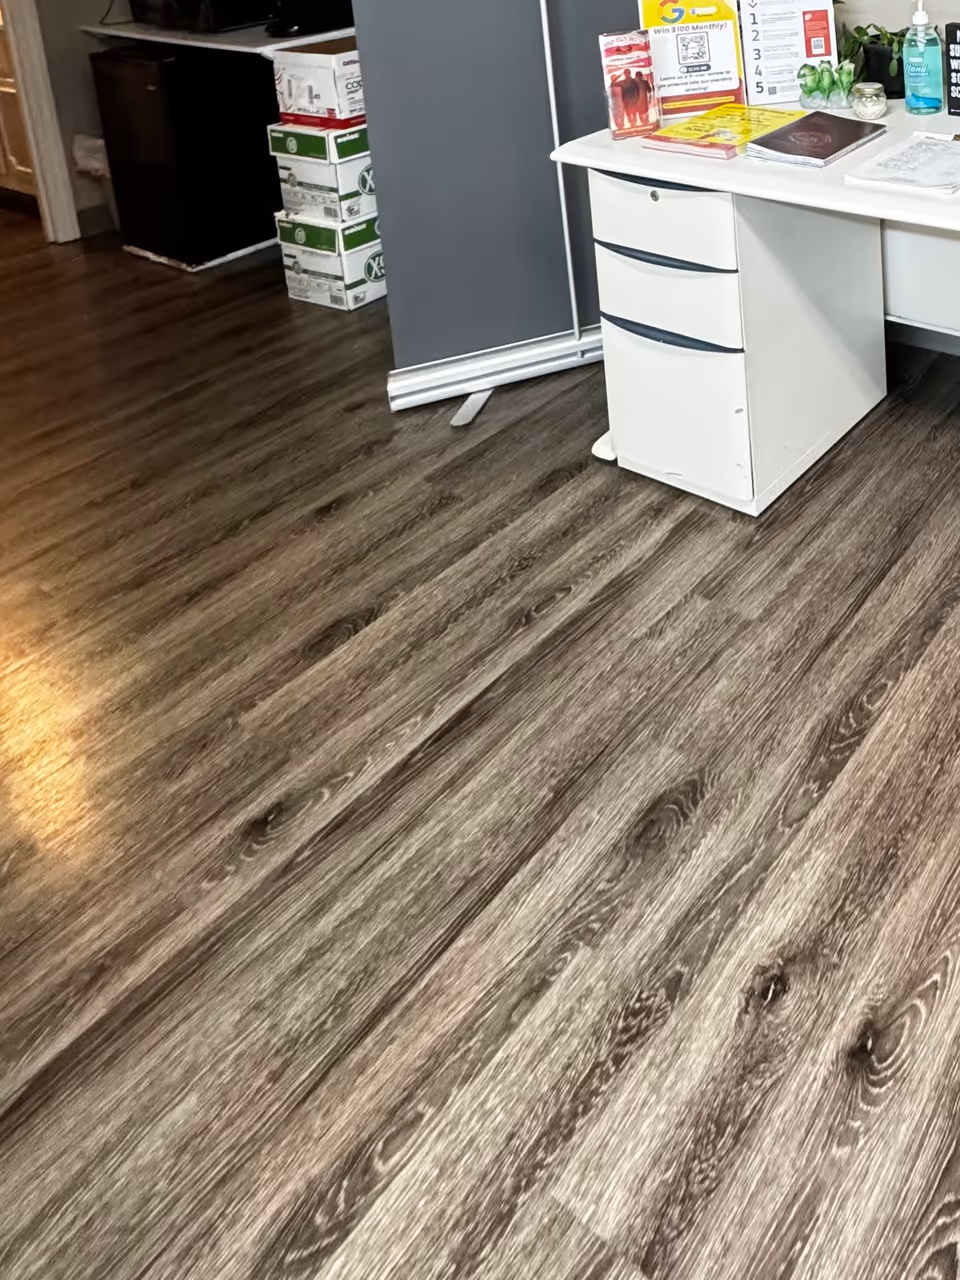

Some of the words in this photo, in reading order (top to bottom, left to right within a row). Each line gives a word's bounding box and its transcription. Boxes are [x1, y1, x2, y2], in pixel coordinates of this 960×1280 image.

[750, 13, 759, 25] 1
[654, 26, 670, 35] Win
[671, 25, 690, 33] $100
[691, 22, 727, 32] Monthly!
[752, 30, 760, 41] 2
[753, 48, 761, 60] 3
[755, 65, 762, 76] 4
[756, 81, 764, 93] 5
